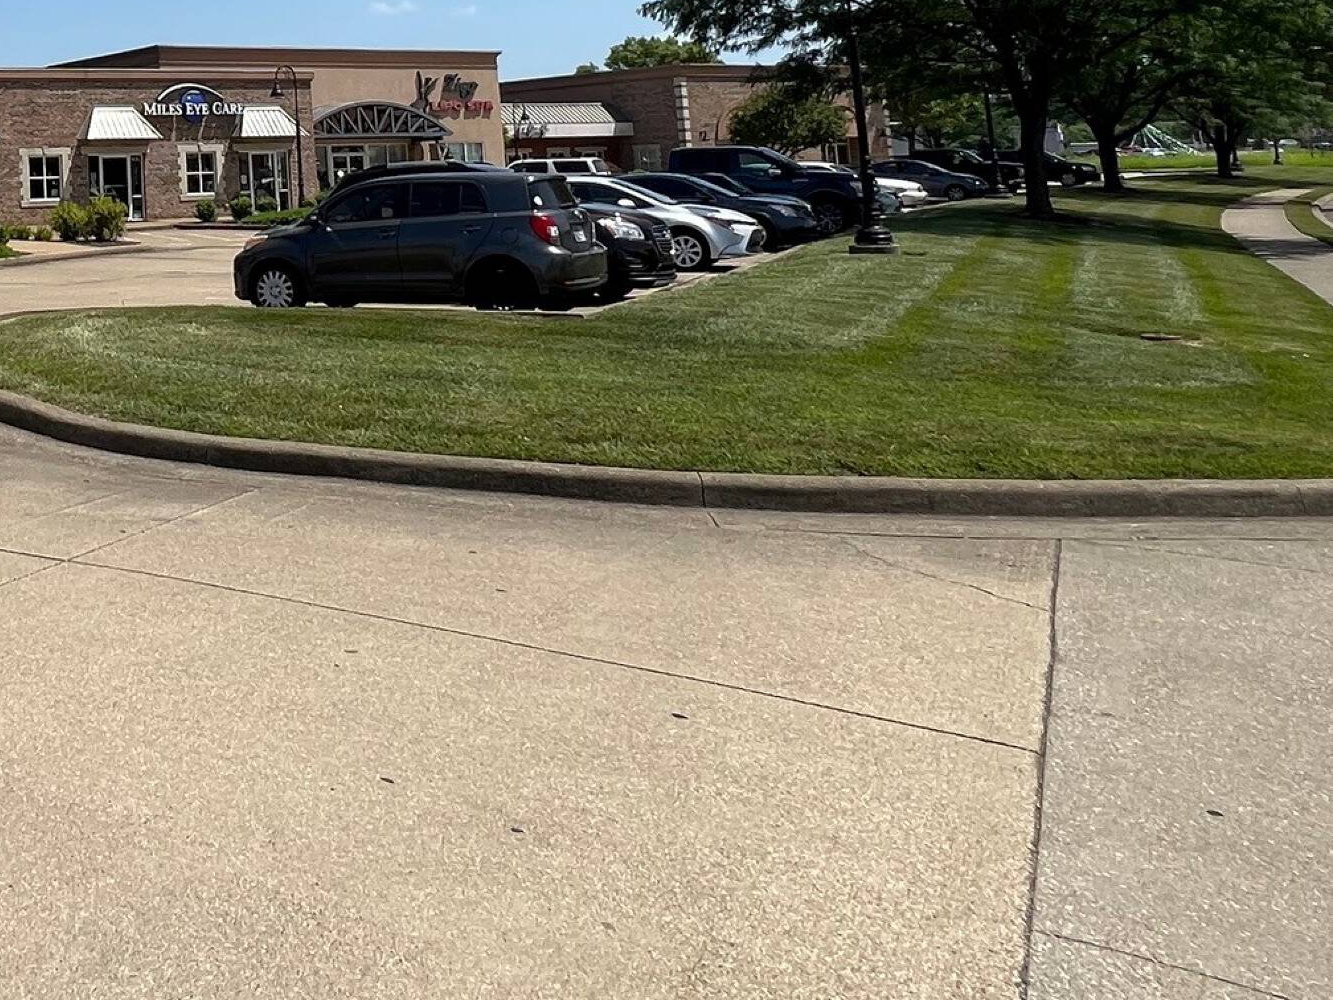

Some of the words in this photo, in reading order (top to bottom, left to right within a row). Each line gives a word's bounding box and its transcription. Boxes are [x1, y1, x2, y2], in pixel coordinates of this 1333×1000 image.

[144, 102, 183, 115] MILES
[185, 102, 210, 115] EYE
[212, 101, 244, 115] CARE
